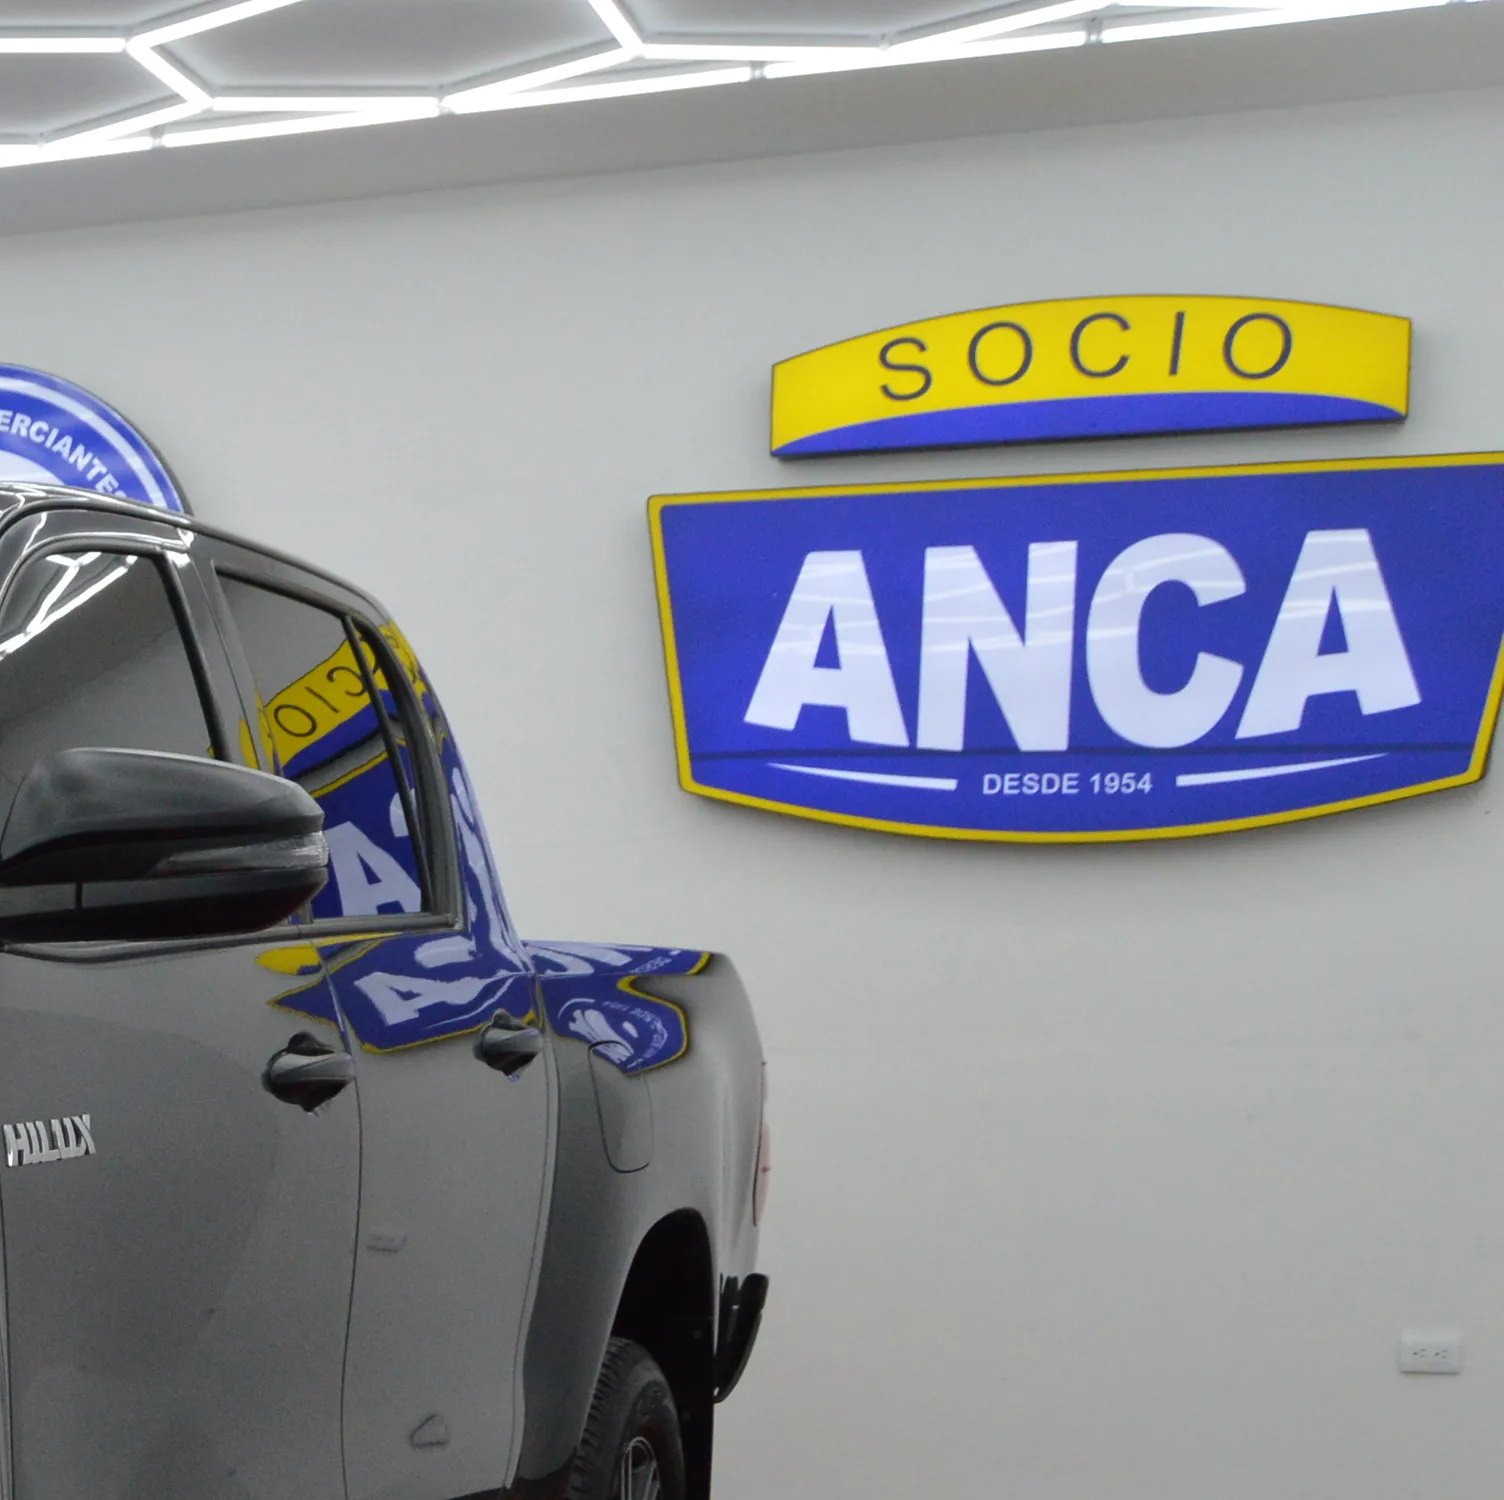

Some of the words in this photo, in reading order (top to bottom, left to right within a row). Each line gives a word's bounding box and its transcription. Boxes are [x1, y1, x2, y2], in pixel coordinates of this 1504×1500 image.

[878, 310, 1293, 401] SOCIO
[743, 527, 1421, 752] ANCA
[981, 771, 1081, 796] DESDE
[1088, 771, 1154, 796] 1954
[2, 1113, 96, 1169] HILUX
